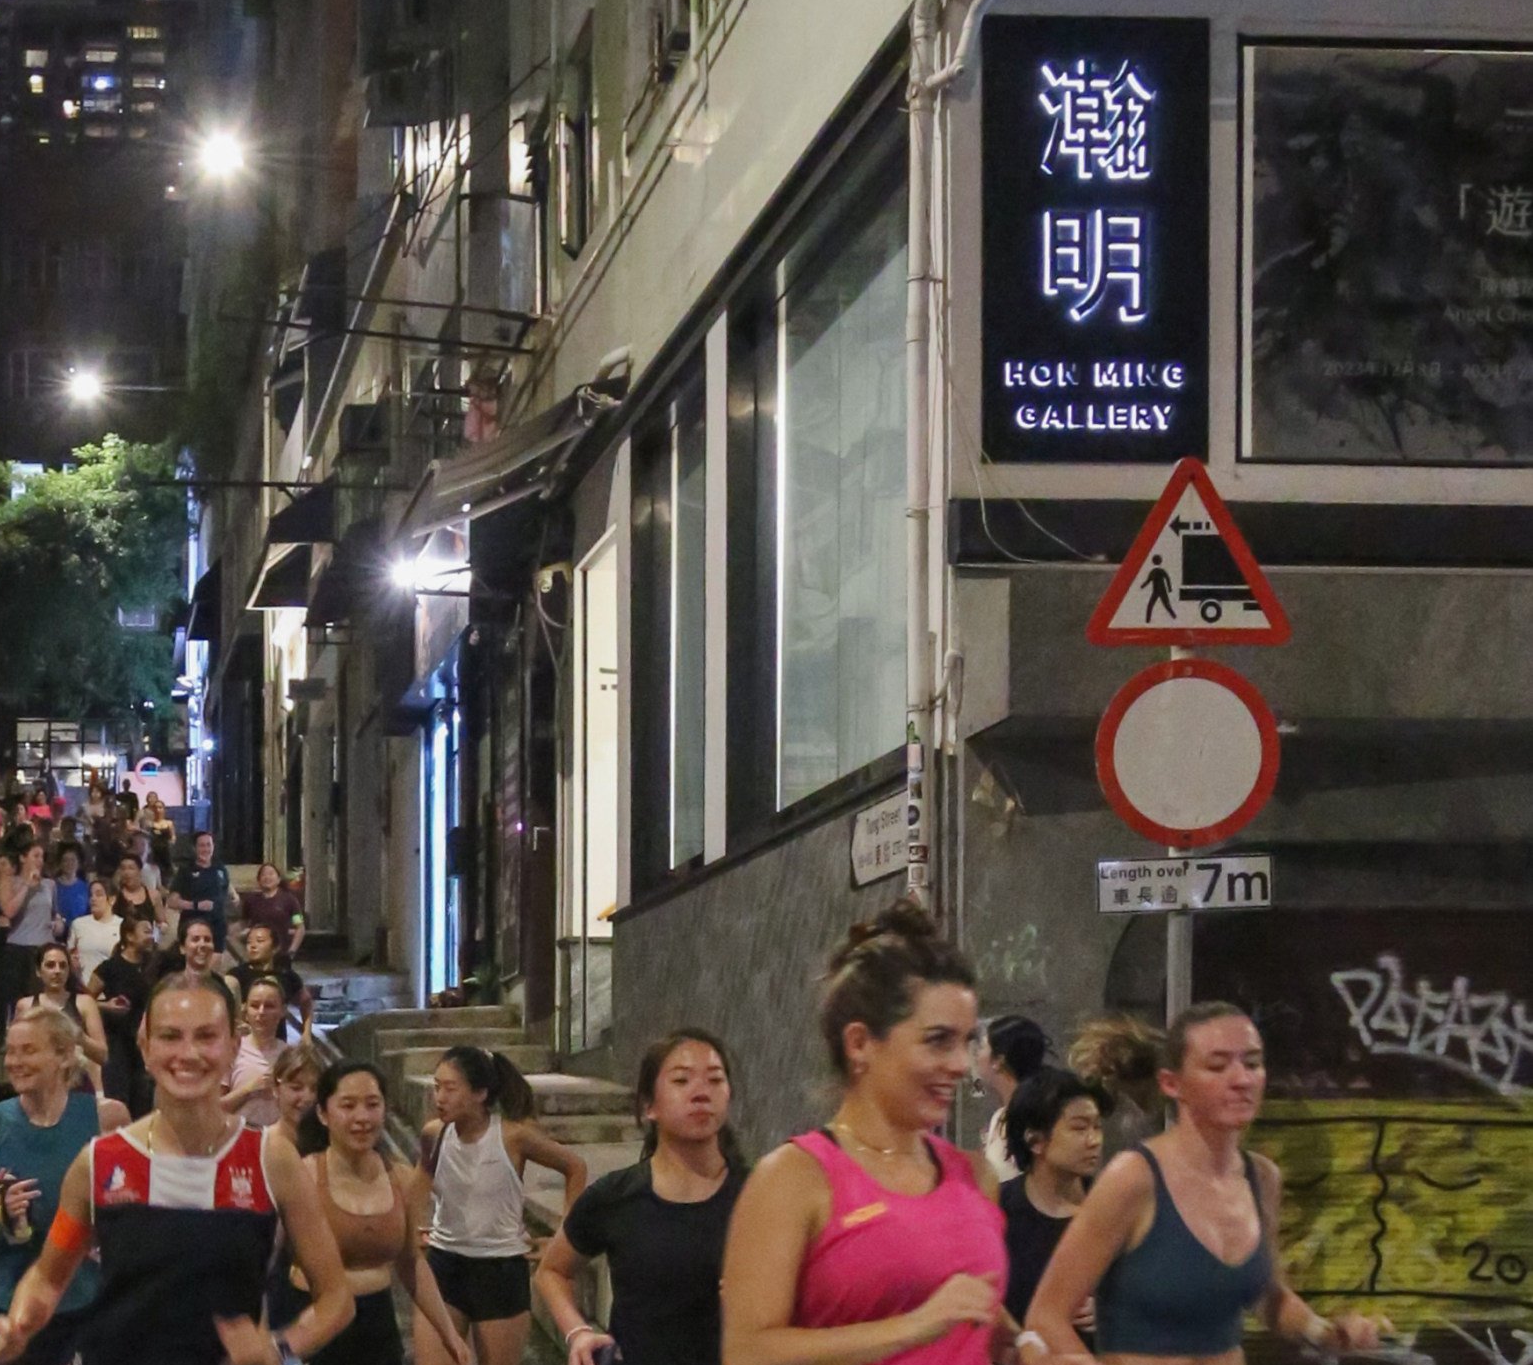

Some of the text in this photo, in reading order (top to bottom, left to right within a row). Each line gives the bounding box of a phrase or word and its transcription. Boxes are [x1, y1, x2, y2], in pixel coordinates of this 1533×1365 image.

[1037, 59, 1156, 323] 瀚明
[1004, 361, 1185, 389] HON MING
[1015, 403, 1172, 431] GALLERY
[1100, 865, 1188, 882] Length over
[1195, 862, 1269, 903] 7m
